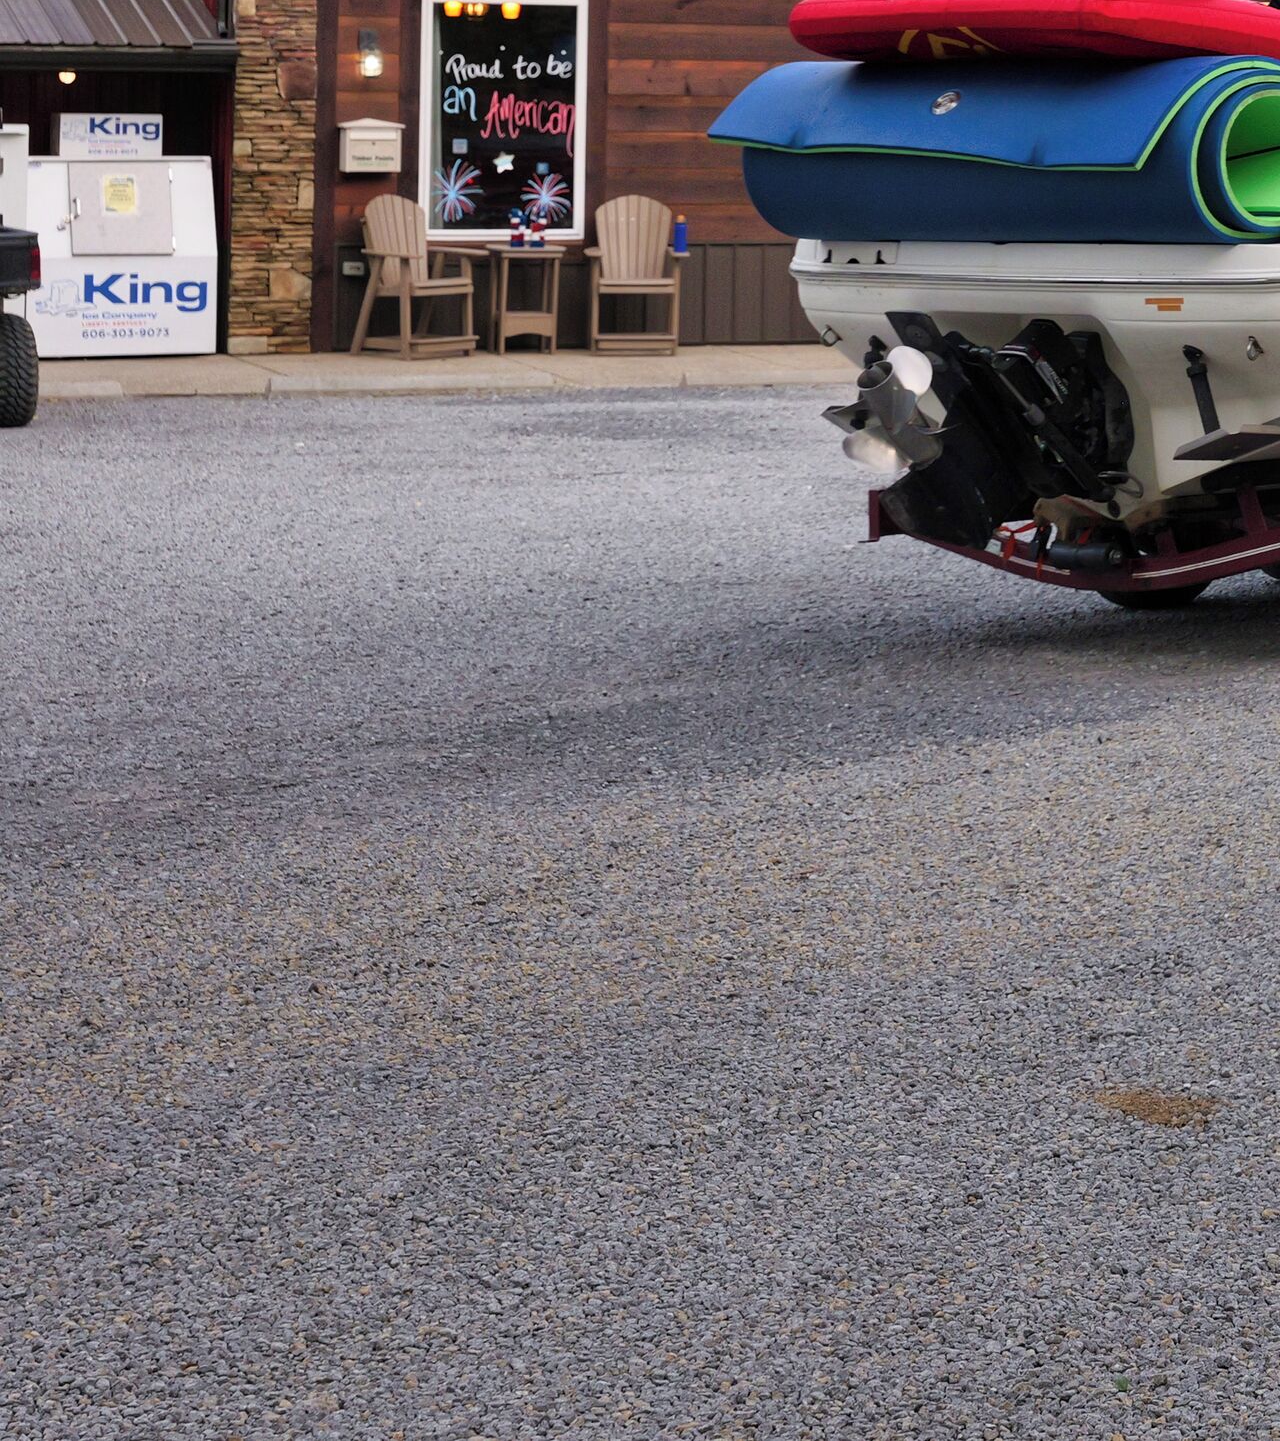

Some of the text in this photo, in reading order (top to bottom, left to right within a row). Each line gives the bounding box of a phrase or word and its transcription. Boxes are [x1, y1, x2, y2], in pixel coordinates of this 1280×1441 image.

[445, 54, 573, 84] Proud to be
[443, 85, 478, 122] an
[89, 116, 160, 140] King
[84, 274, 208, 313] King
[82, 312, 99, 320] Ice
[102, 311, 158, 321] Company
[82, 328, 169, 339] 606-303-9073
